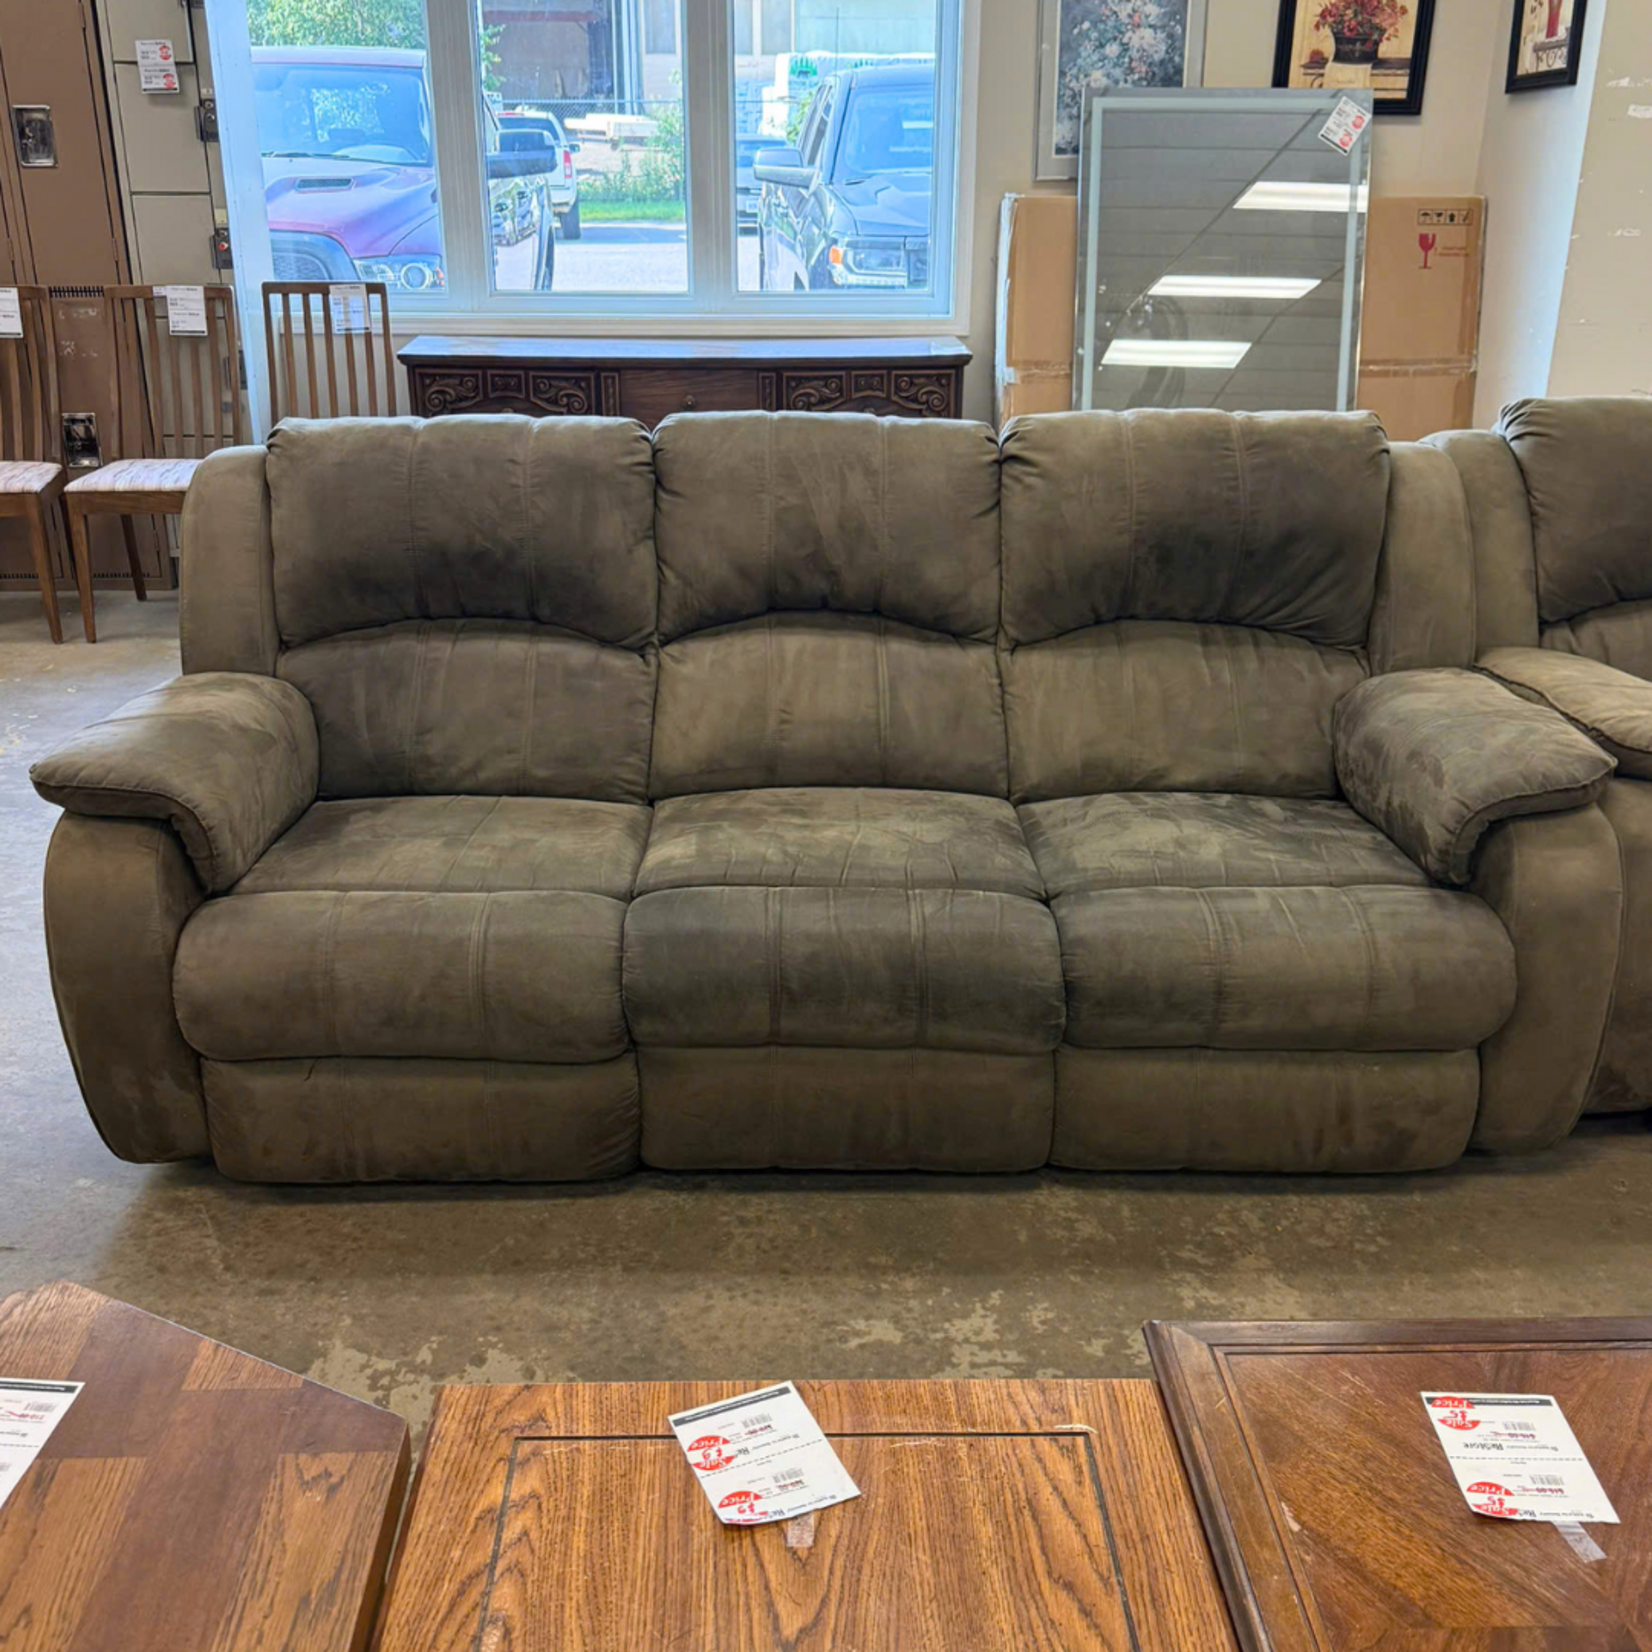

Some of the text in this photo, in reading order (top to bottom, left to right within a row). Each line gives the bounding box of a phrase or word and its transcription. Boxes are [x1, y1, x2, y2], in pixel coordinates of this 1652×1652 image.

[1435, 1400, 1468, 1409] Price
[1445, 1419, 1473, 1428] Sale
[691, 1437, 724, 1449] Price
[699, 1459, 727, 1469] Sale
[1469, 1485, 1506, 1496] Price
[721, 1492, 754, 1505] Price
[1480, 1504, 1510, 1515] Sale
